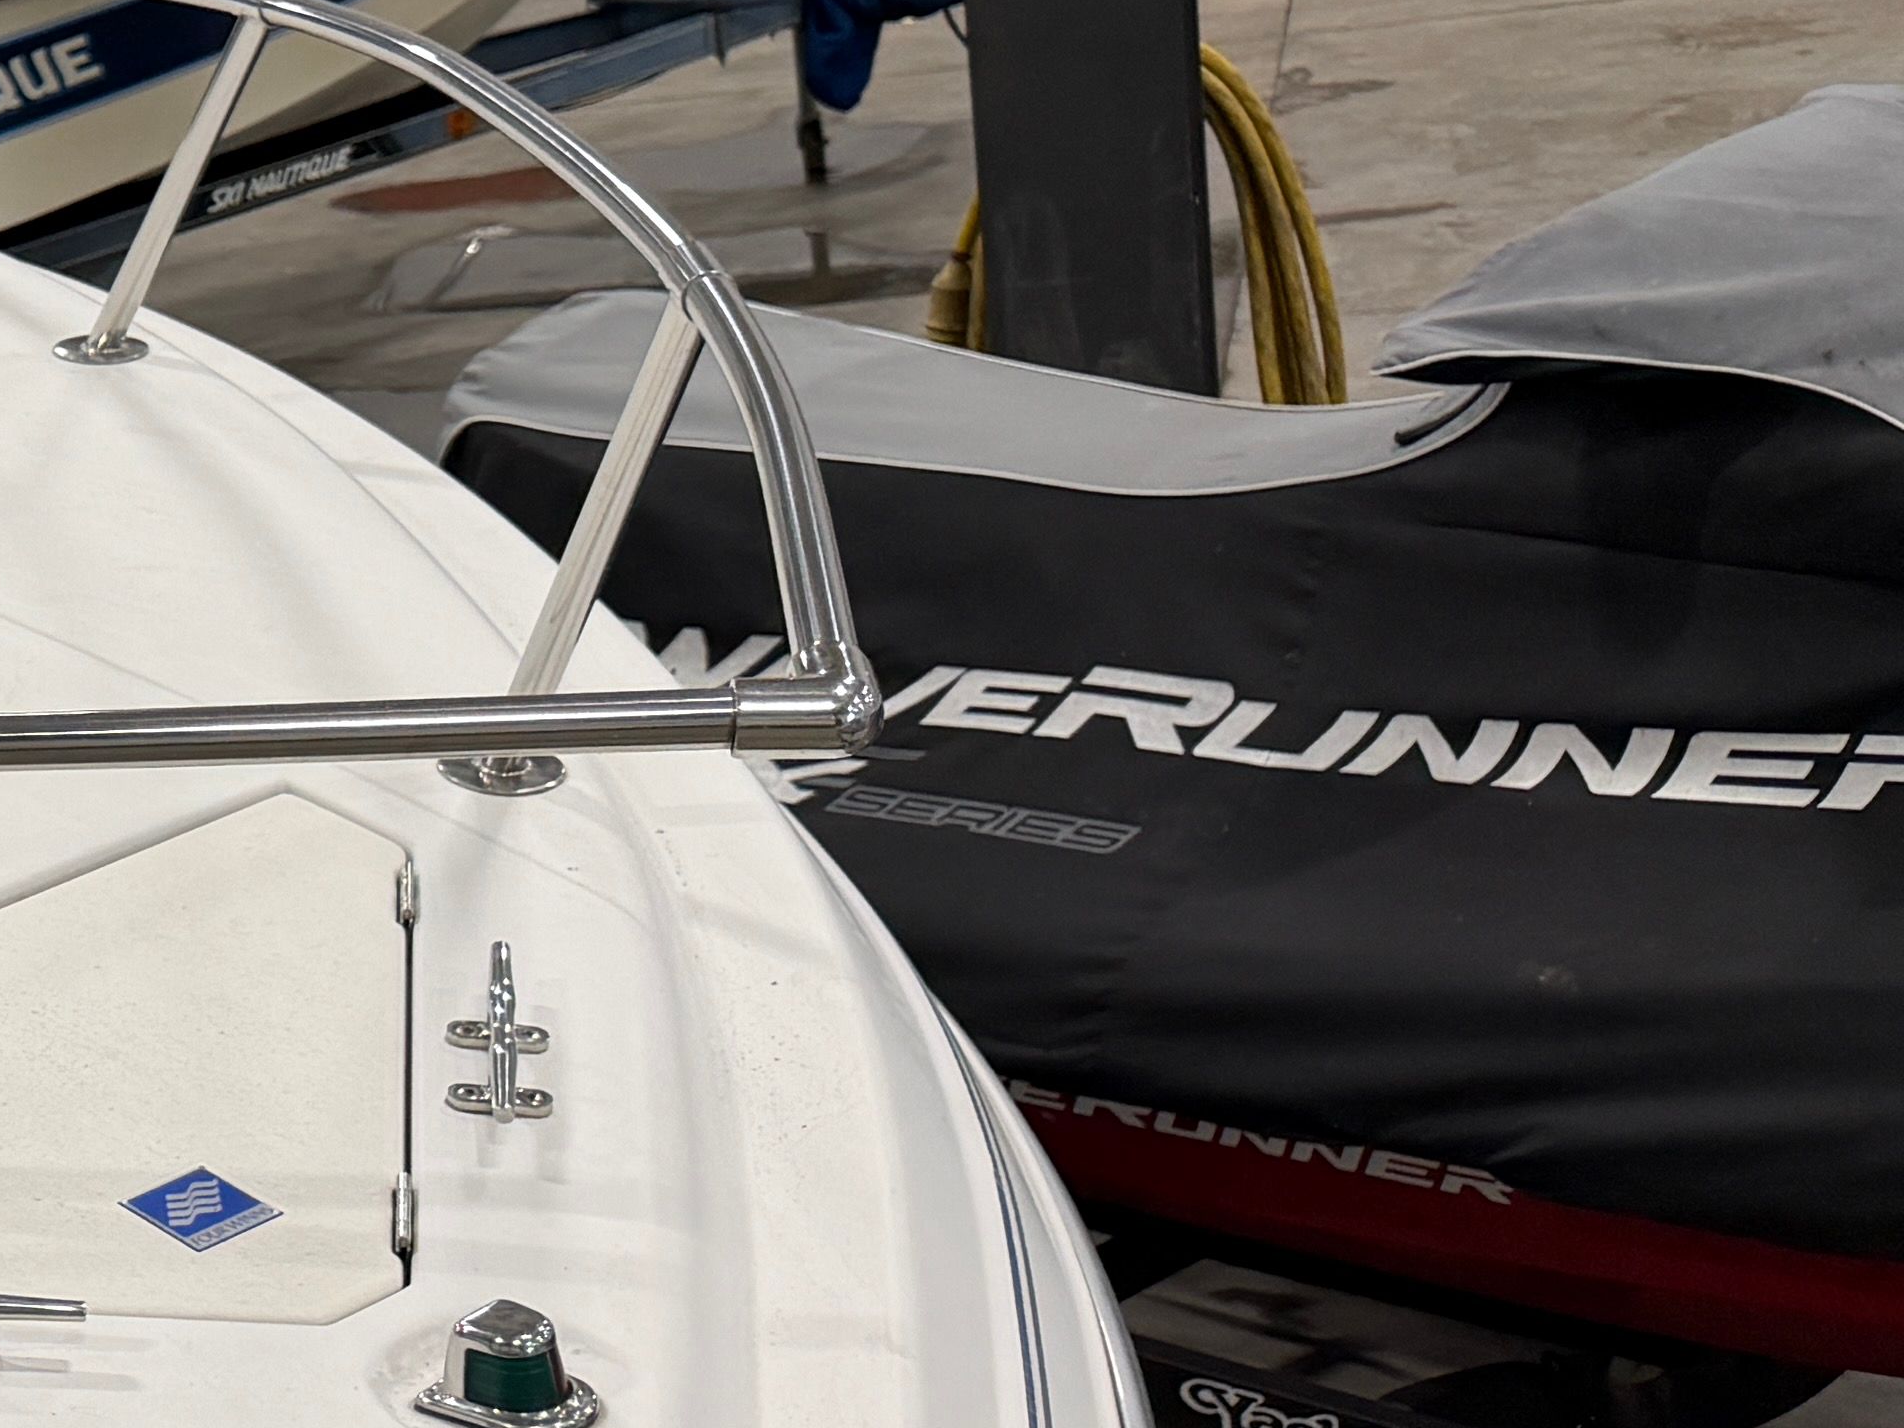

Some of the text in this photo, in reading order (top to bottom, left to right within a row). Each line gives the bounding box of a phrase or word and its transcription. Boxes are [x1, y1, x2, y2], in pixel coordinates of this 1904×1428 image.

[247, 143, 354, 202] NAUTIQUE
[621, 618, 1904, 811] WERUNNE
[825, 784, 1143, 855] SERIES
